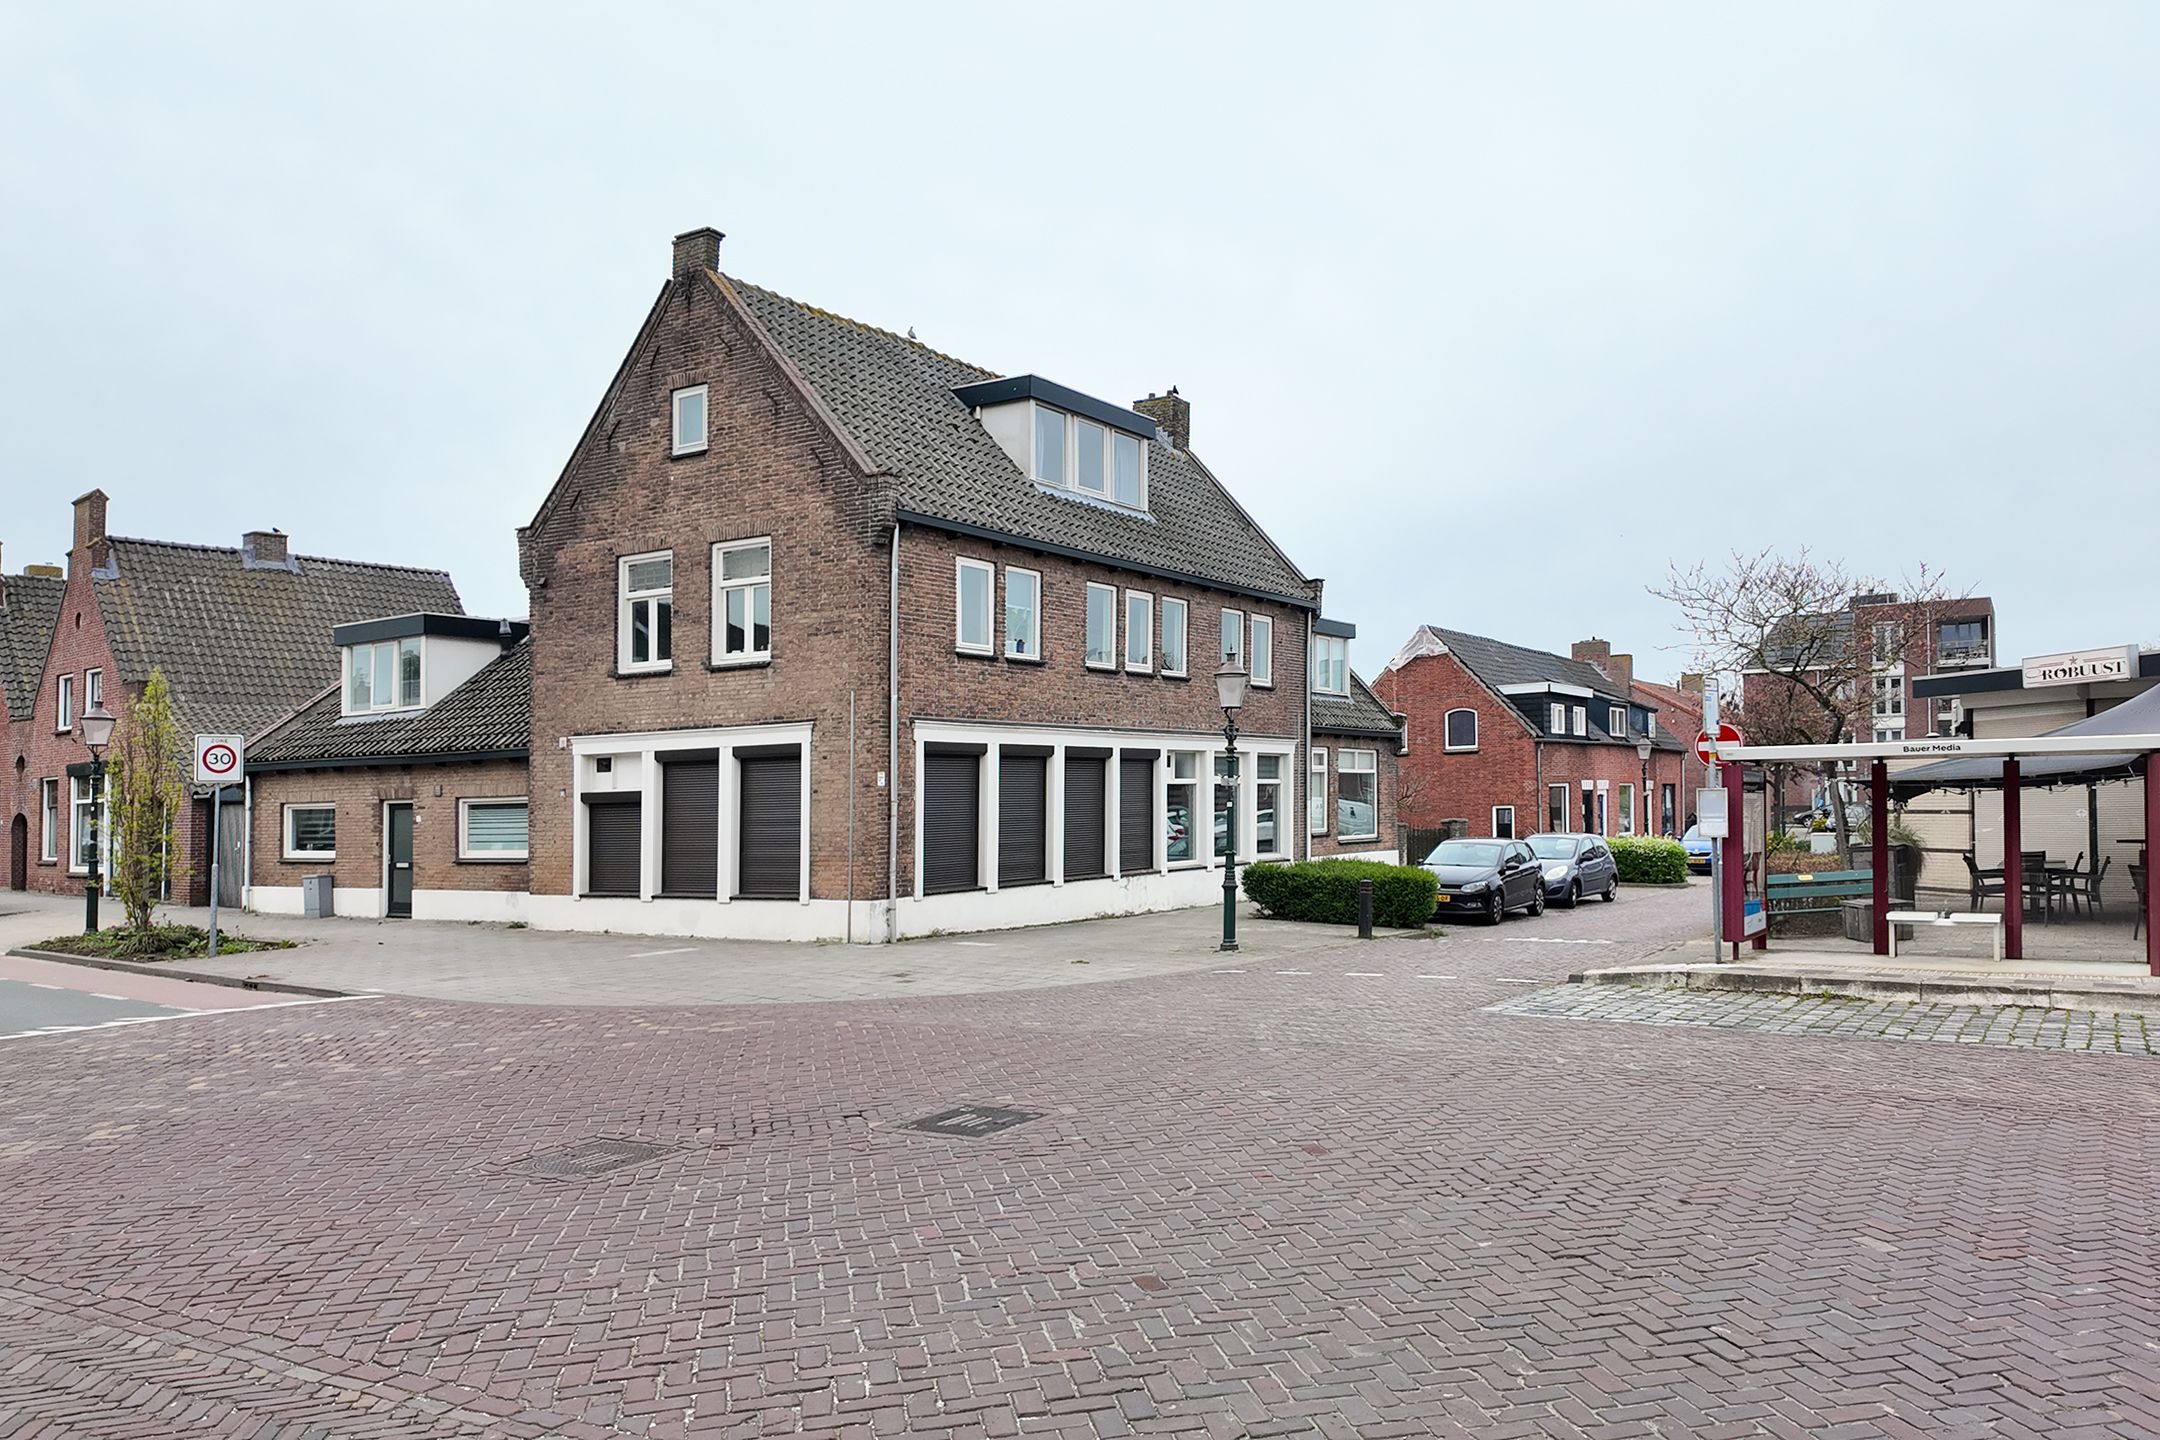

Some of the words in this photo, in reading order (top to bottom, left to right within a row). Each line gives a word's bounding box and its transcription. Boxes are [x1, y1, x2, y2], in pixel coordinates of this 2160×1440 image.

[2041, 660, 2126, 680] ROBUUST
[1903, 745, 1931, 753] Bauer
[1932, 743, 1961, 752] Media
[208, 752, 231, 765] 30
